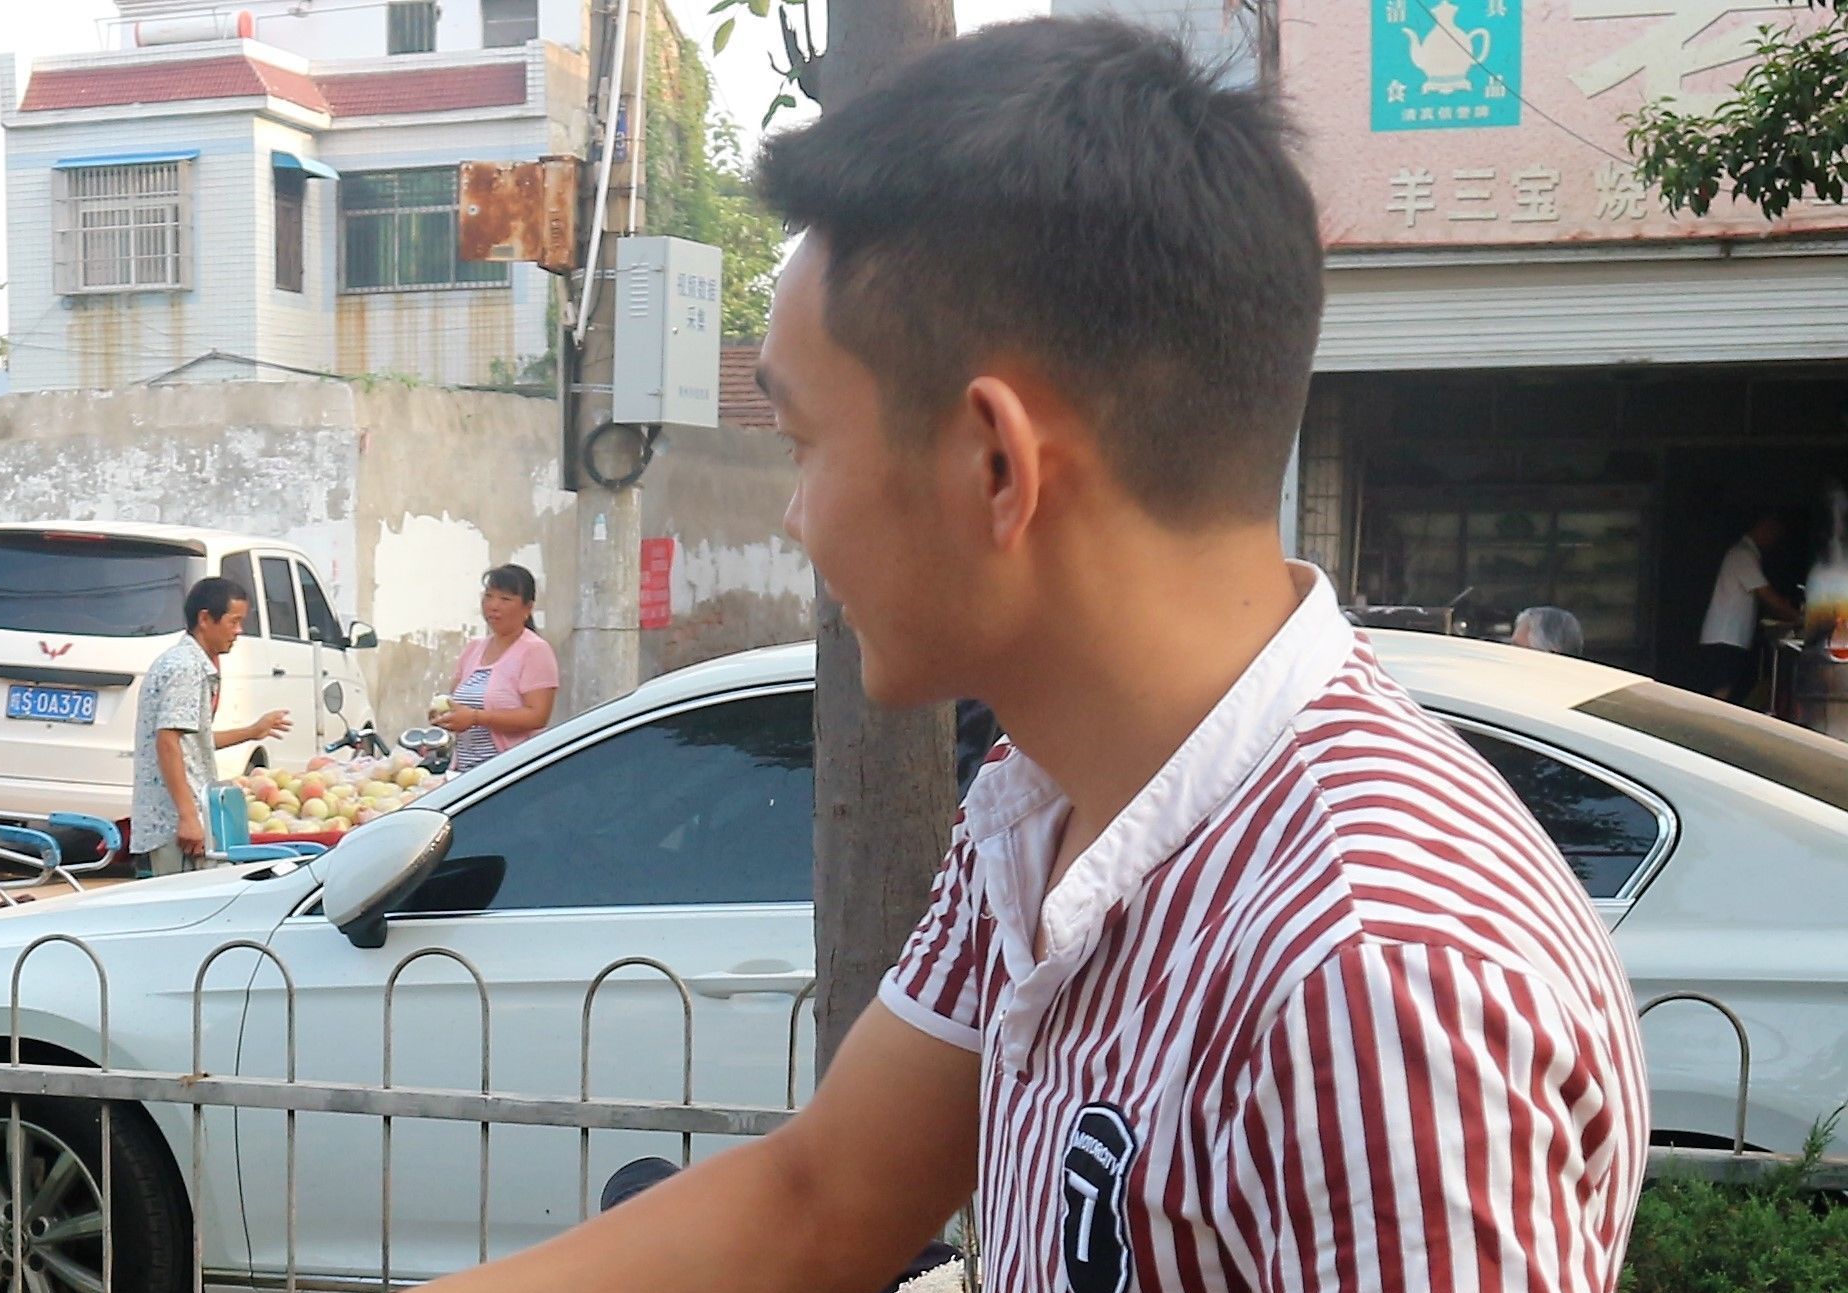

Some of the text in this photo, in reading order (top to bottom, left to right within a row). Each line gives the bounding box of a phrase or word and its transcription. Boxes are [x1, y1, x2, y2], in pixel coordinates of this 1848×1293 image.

[1387, 79, 1407, 103] 食
[1386, 164, 1561, 228] 羊三宝
[1064, 1167, 1100, 1263] 7
